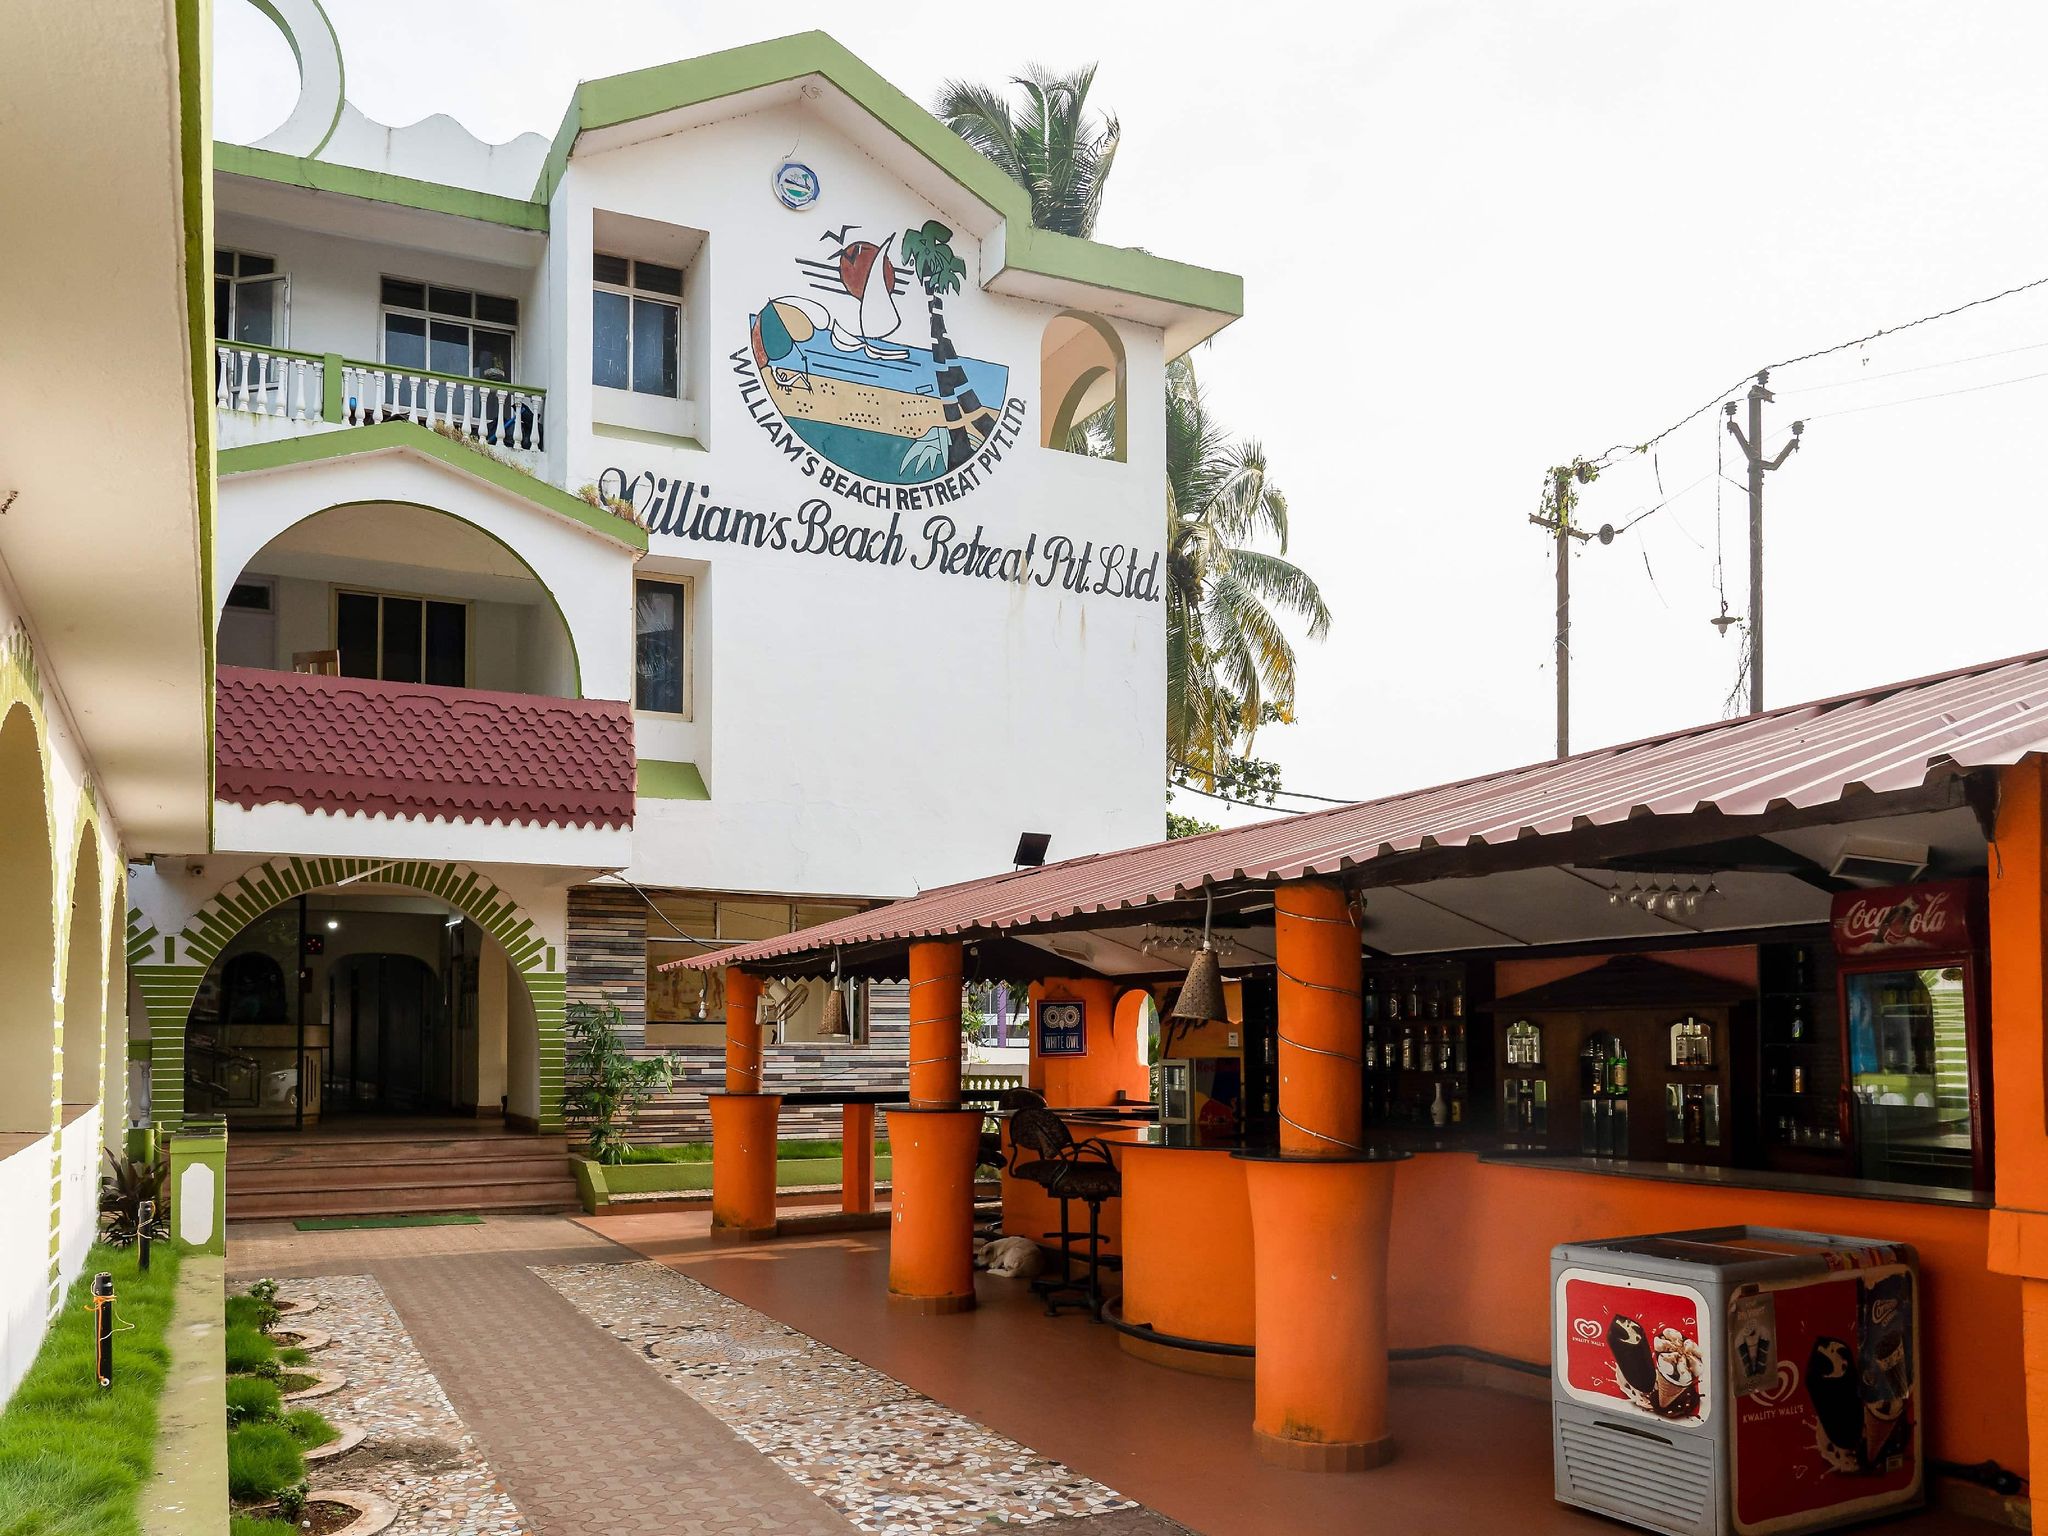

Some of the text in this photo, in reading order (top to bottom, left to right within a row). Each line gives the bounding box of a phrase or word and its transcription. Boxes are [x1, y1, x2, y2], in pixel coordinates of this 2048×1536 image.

[729, 346, 820, 477] WILLIAM'S
[819, 465, 891, 509] BEACH
[895, 462, 981, 511] RETREAT
[977, 428, 1014, 475] PVT.
[598, 467, 1160, 602] William's Beach Retreat Pvt. Ltd.
[1909, 892, 1950, 934] ola
[1044, 1035, 1080, 1049] WHITE OWL
[1742, 1404, 1804, 1424] KWALITY WALL'S
